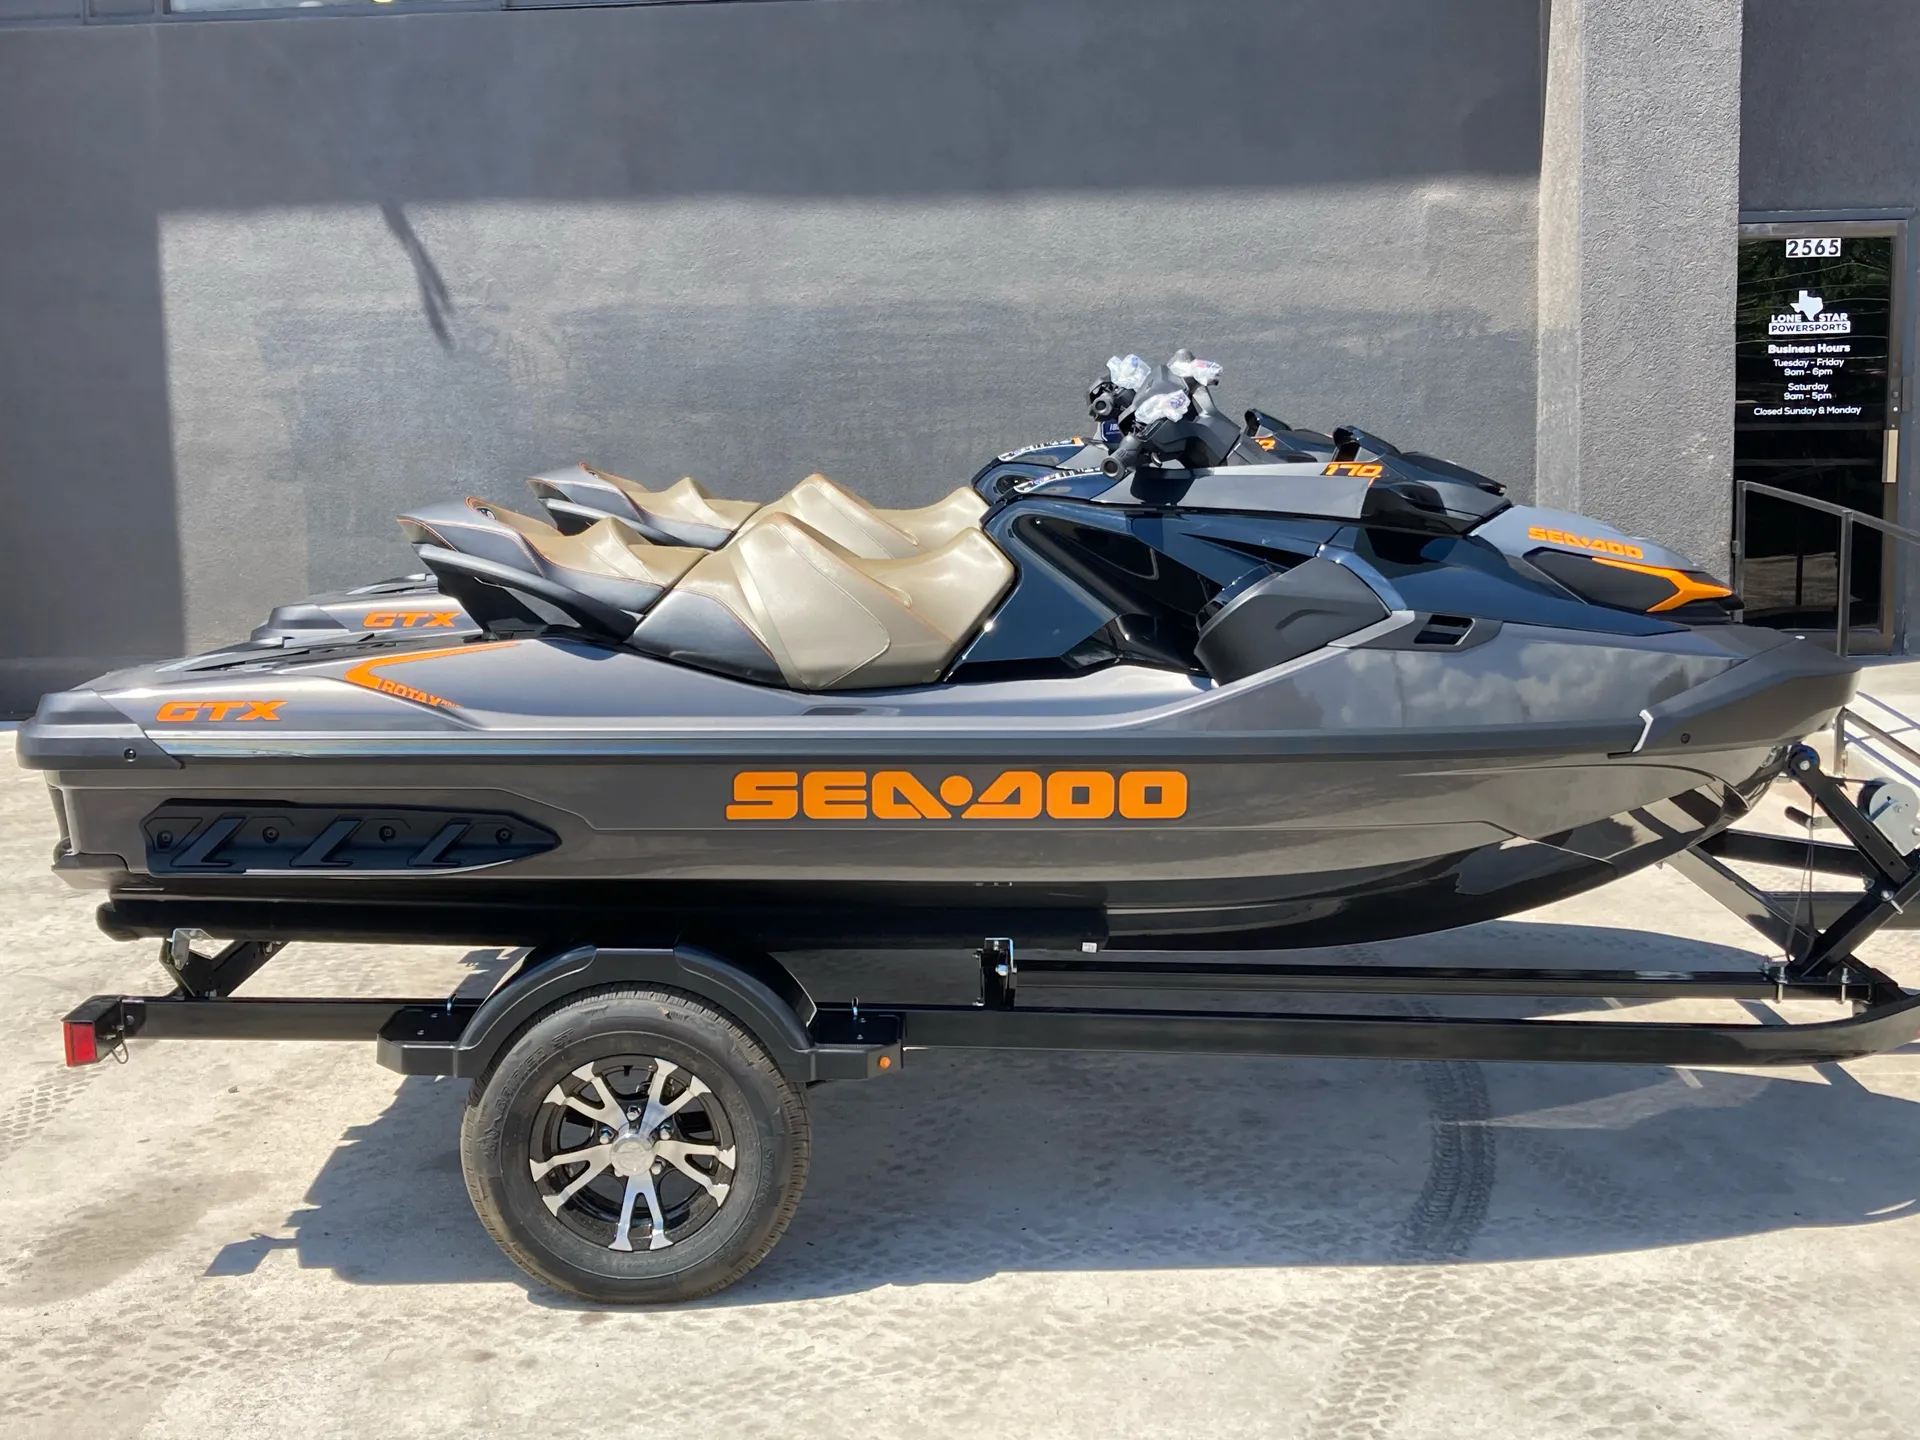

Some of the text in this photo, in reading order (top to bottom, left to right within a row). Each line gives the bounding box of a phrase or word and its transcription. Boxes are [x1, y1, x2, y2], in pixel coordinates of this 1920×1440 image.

[1787, 239, 1840, 257] 2565
[1770, 312, 1849, 323] LONE STAR
[1770, 323, 1848, 332] POWERSPORTS
[1767, 343, 1851, 354] Business Hours
[1773, 358, 1810, 368] Tuesday
[1816, 357, 1845, 368] Friday
[1783, 367, 1805, 376] 9am
[1811, 367, 1833, 377] 6pm
[1787, 382, 1829, 392] Saturday
[1783, 391, 1804, 400] 9am
[1811, 391, 1832, 401] 5pm
[1753, 405, 1862, 417] Closed Sunday & Monday
[1324, 463, 1384, 477] 170
[362, 611, 461, 629] GTX
[380, 679, 442, 707] ROTAX
[156, 700, 288, 723] GTX
